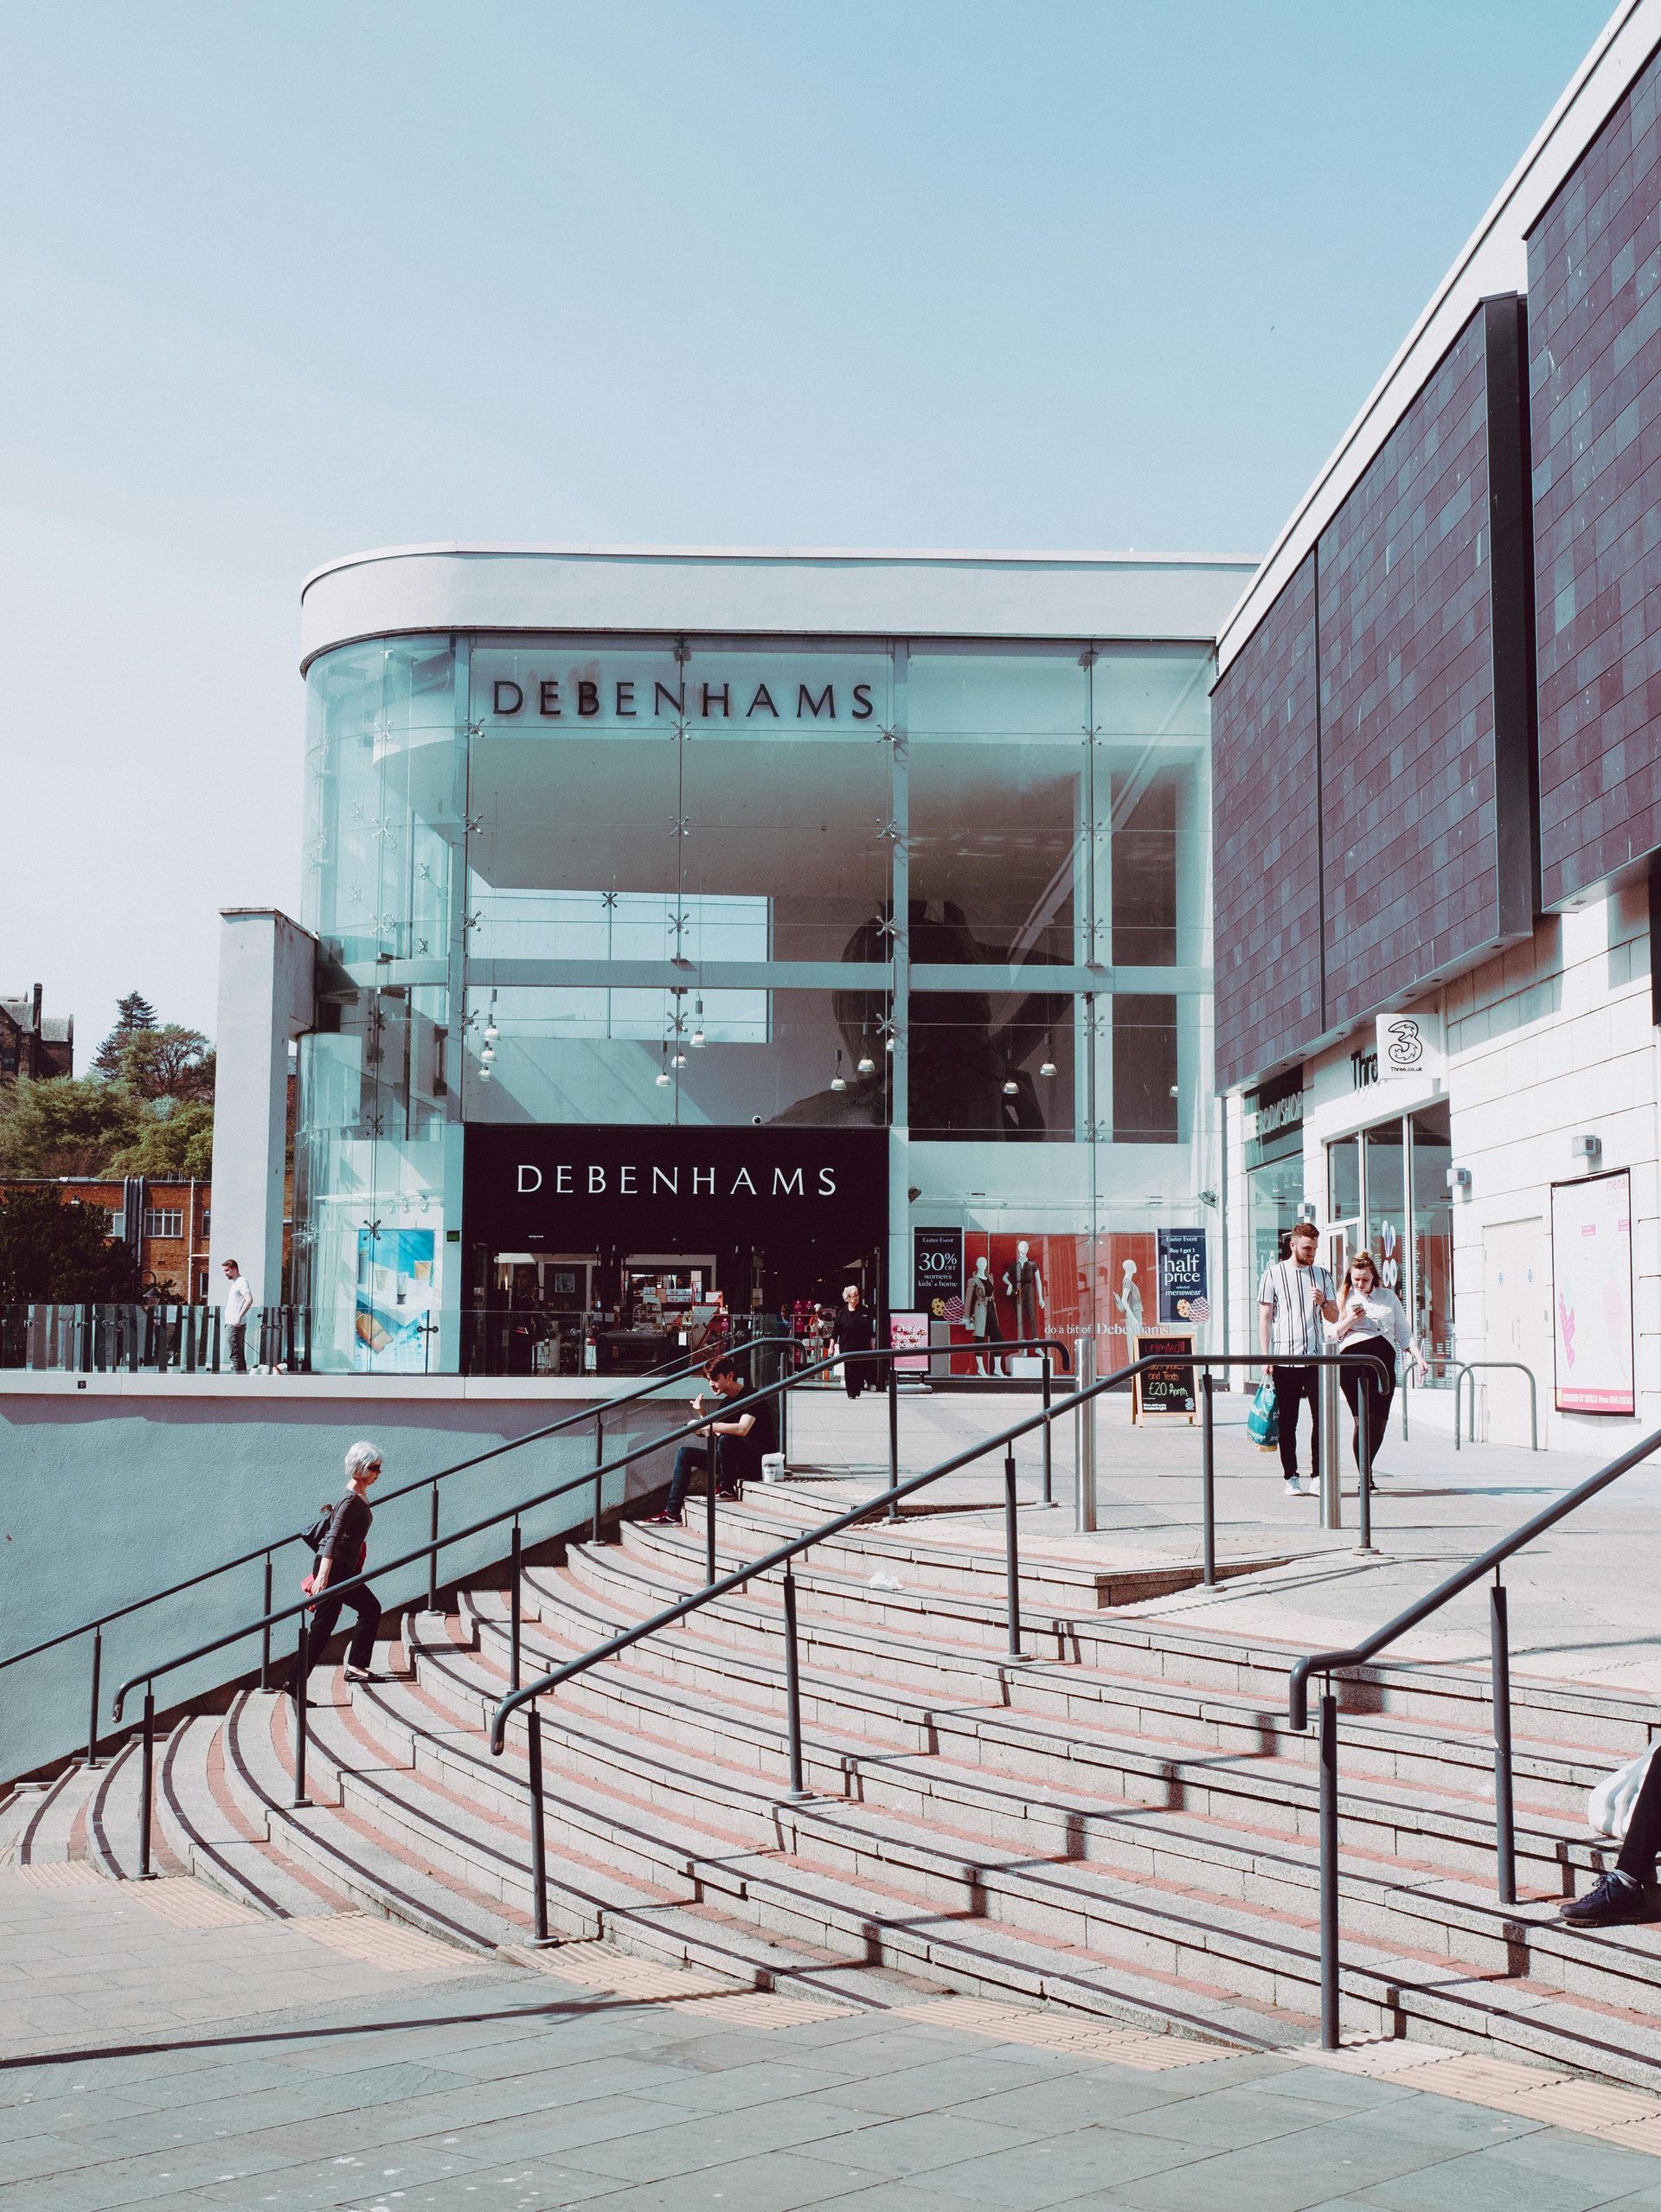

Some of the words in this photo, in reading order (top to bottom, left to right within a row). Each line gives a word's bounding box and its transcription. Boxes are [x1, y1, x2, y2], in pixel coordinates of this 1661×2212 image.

[492, 680, 874, 719] DEBENHAMS
[1388, 1019, 1423, 1065] 3
[516, 1164, 837, 1196] DEBENHAMS
[919, 1253, 958, 1271] 30%
[1164, 1253, 1200, 1273] half
[1164, 1273, 1201, 1286] price
[1044, 1324, 1057, 1334] do
[1066, 1324, 1081, 1334] bit
[1081, 1324, 1093, 1334] of
[1097, 1323, 1169, 1336] Debeams
[1148, 1371, 1161, 1381] and
[1149, 1382, 1168, 1396] £20
